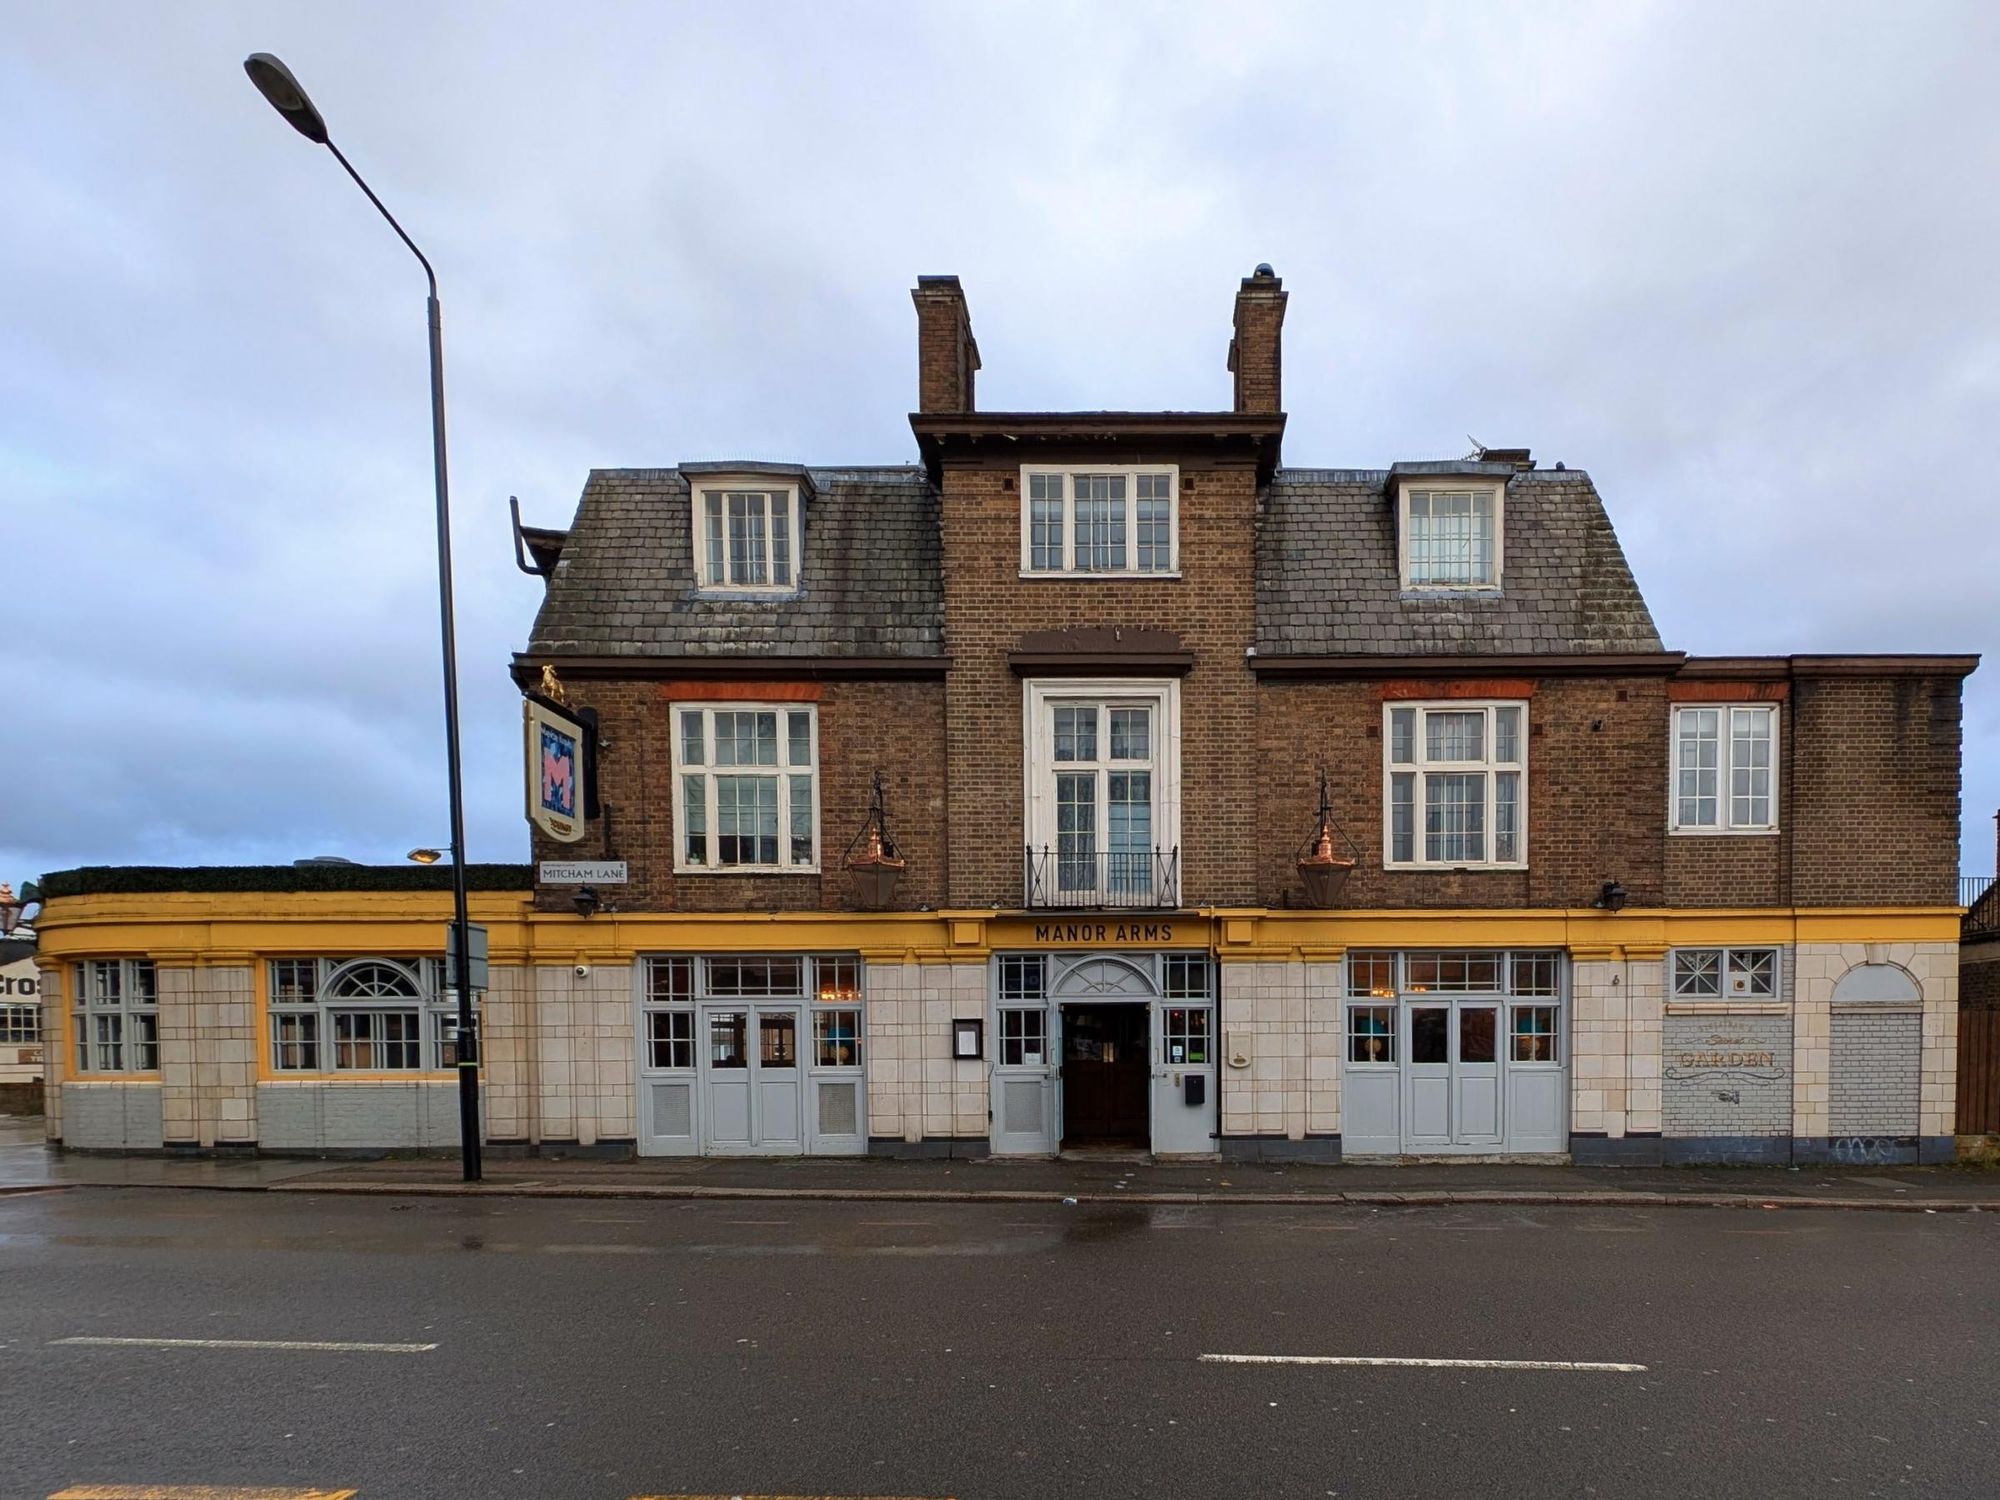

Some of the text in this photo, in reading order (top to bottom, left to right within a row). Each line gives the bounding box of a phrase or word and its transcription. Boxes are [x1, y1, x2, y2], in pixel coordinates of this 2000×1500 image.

[543, 746, 571, 810] M
[543, 869, 625, 879] MITCHAM LANE
[1035, 924, 1172, 942] MANOR ARMS
[1680, 1051, 1775, 1068] GARDEN
